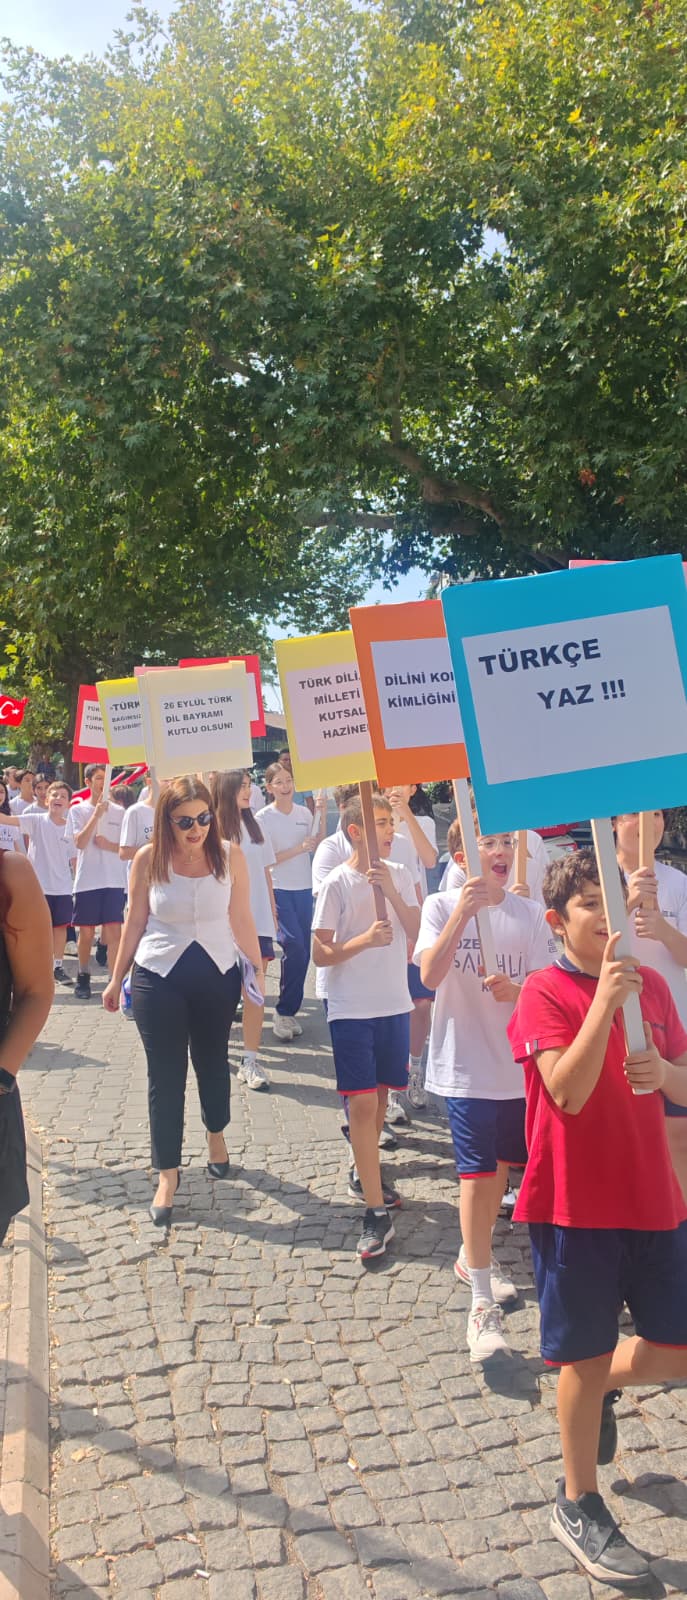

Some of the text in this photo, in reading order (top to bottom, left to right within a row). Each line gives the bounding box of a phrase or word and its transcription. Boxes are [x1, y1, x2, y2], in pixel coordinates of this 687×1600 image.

[479, 637, 601, 676] TÜRKÇE
[299, 670, 361, 690] TÜRK DİLİ
[384, 672, 426, 687] DİLİNİ
[388, 690, 456, 708] KİMLİĞİNİ
[537, 679, 627, 710] YAZ !!!
[163, 695, 233, 710] 26 EYLÜL TÜRK
[165, 710, 224, 724] DİL BAYRAMI
[319, 707, 366, 722] KUTSAL
[167, 722, 234, 737] KUTLU OLSUN!
[323, 723, 370, 739] HAZİNE
